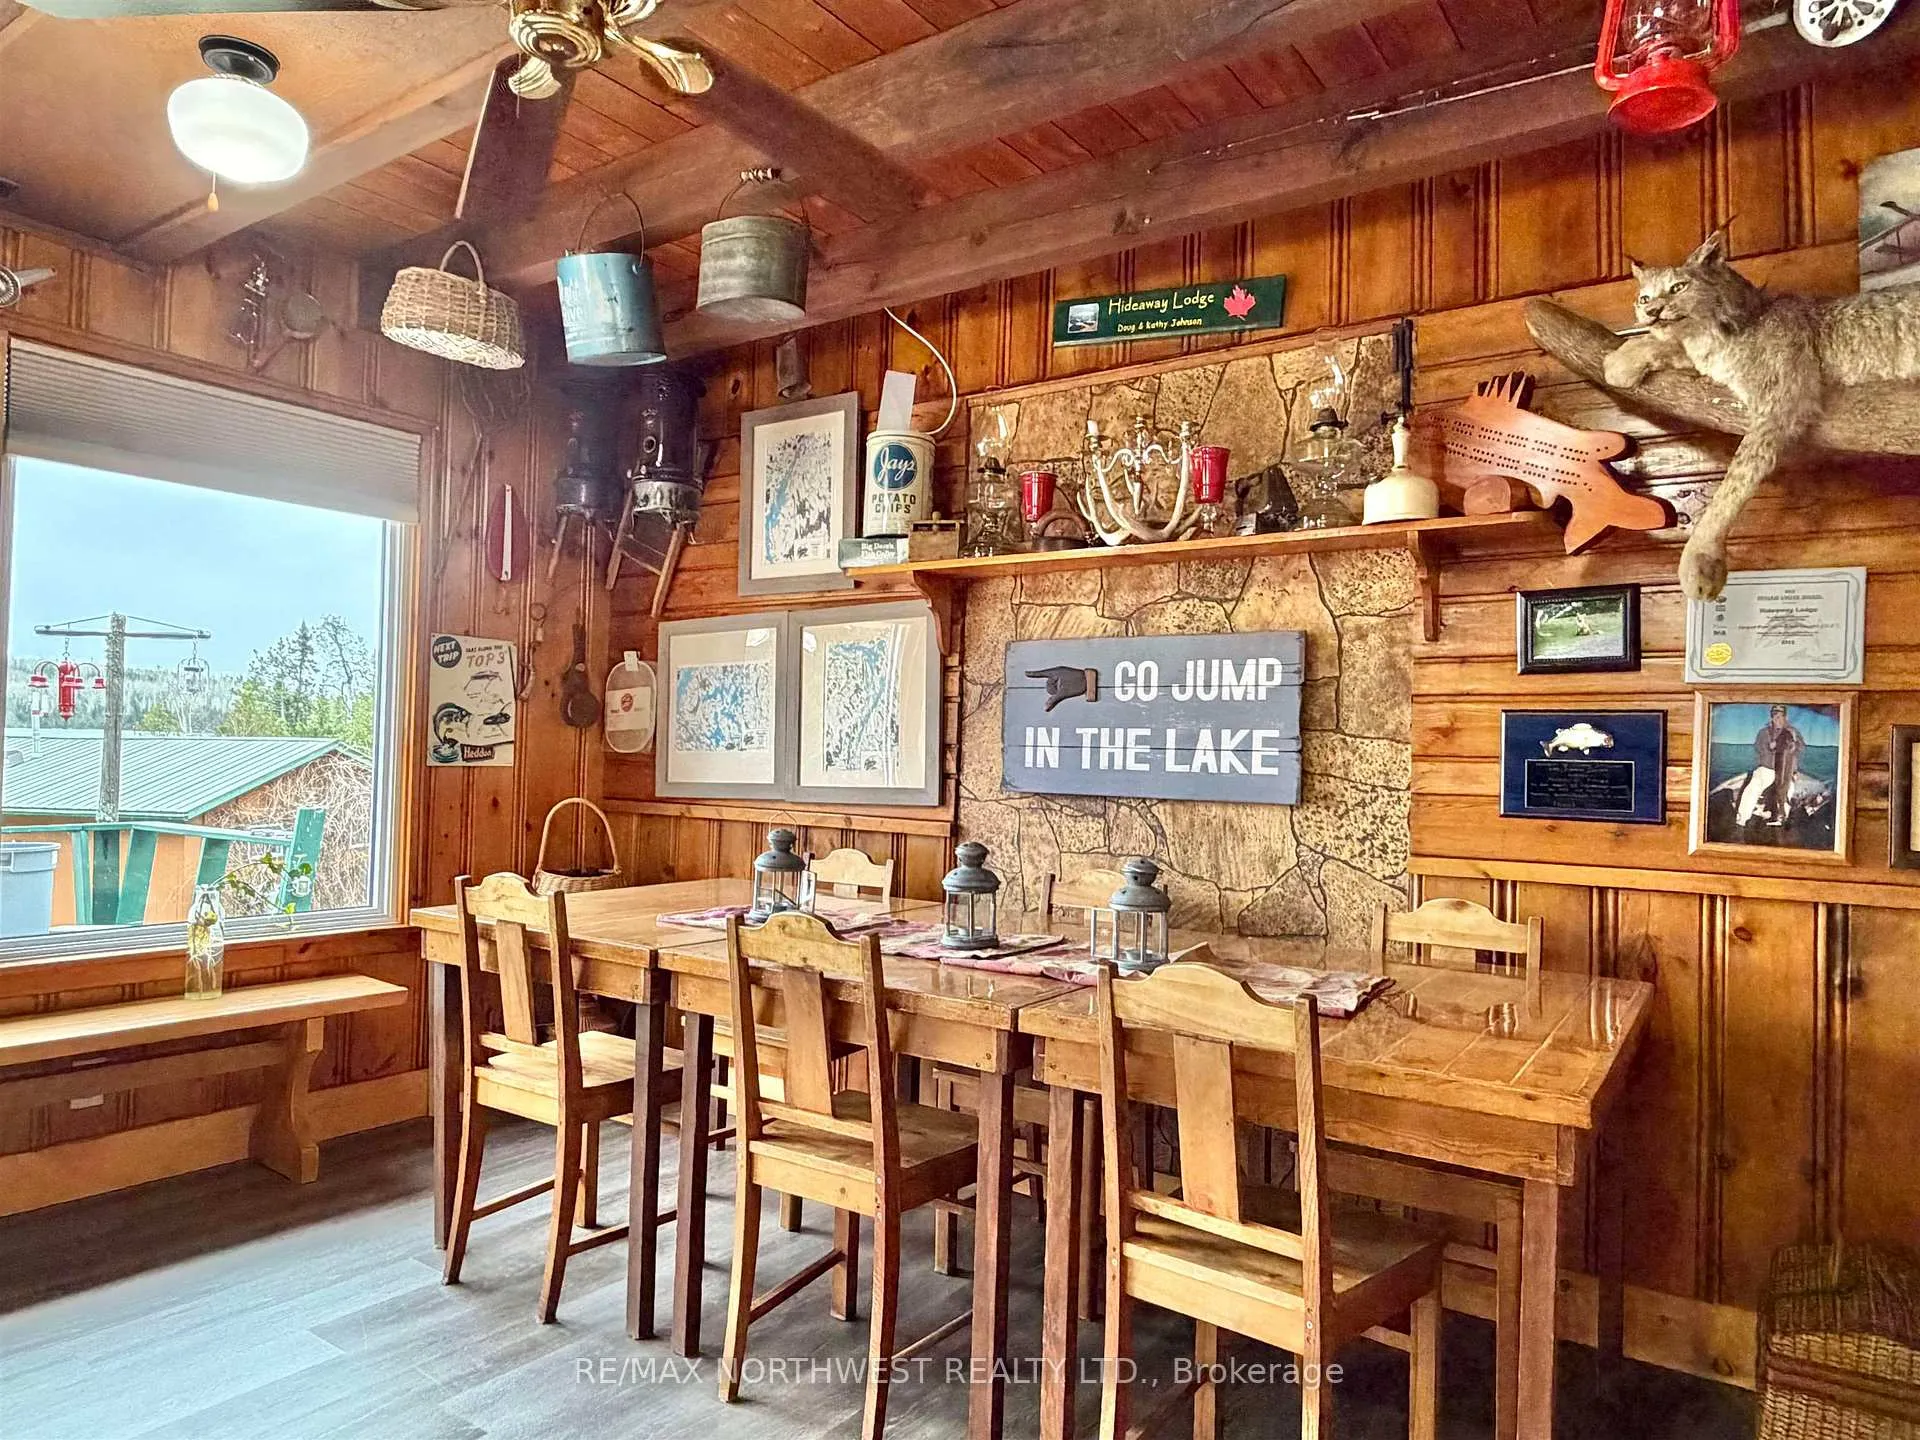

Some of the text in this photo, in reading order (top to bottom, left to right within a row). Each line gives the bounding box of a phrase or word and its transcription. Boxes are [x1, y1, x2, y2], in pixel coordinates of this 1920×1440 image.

[1108, 292, 1215, 315] Hideaway Lodge
[1117, 323, 1136, 333] Doug
[1146, 321, 1168, 331] Kathy
[1171, 317, 1202, 327] Johnson
[878, 446, 916, 482] Jays
[871, 493, 916, 505] POTATO
[433, 641, 456, 654] NEXT
[438, 651, 459, 664] TRIP
[466, 652, 495, 668] TOP
[1113, 658, 1283, 702] GO JUMP
[1024, 727, 1281, 776] IN THE LAKE
